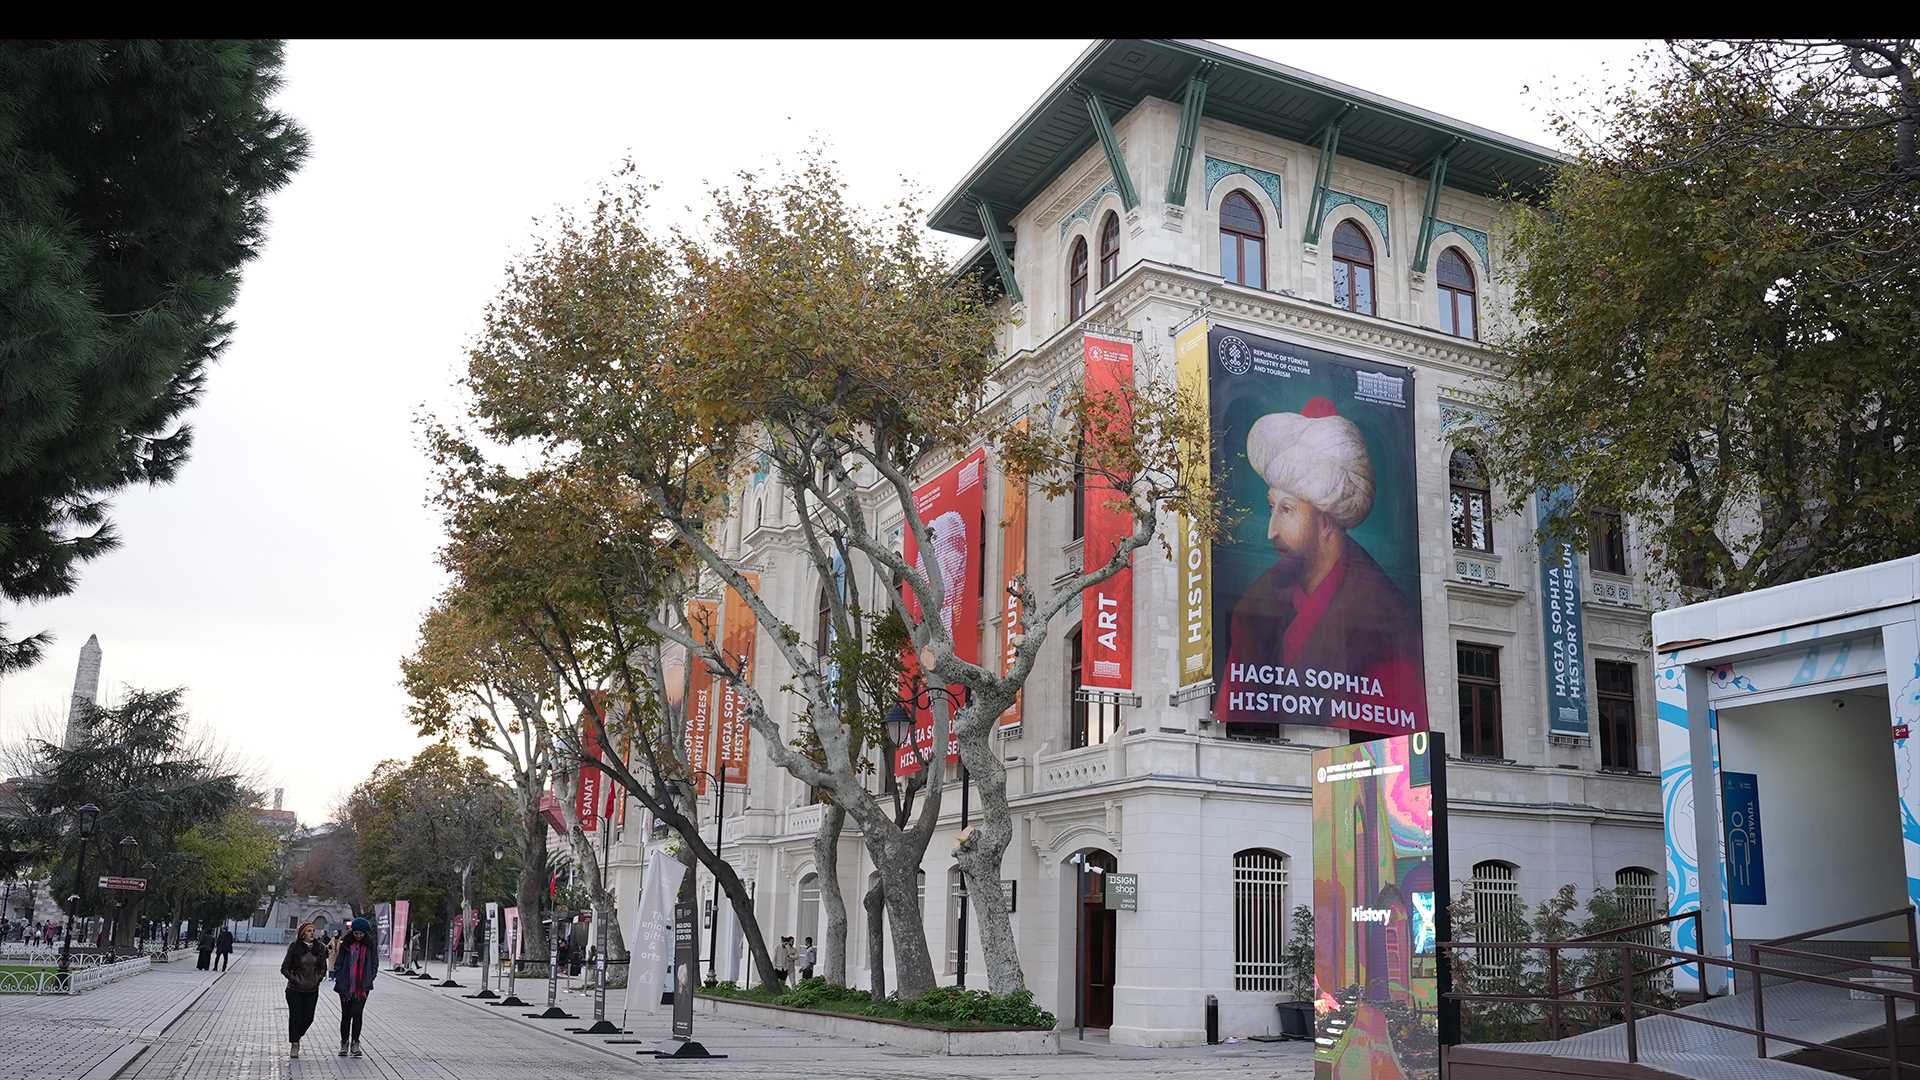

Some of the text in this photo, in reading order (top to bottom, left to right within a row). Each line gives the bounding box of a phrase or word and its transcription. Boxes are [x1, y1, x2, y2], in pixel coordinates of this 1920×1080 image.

[1253, 364, 1291, 378] AND TOURISM
[1098, 592, 1118, 651] ART
[1549, 567, 1566, 697] HAGIA SOPHIA
[1561, 543, 1581, 699] HISTORY MUSEUM
[1230, 663, 1384, 697] HAGIA SOPHIA
[1229, 692, 1416, 729] HISTORY MUSEUM
[722, 721, 733, 761] HAGIA
[583, 777, 594, 816] SANAT
[1747, 801, 1756, 845] TUVALET
[1351, 905, 1391, 926] History
